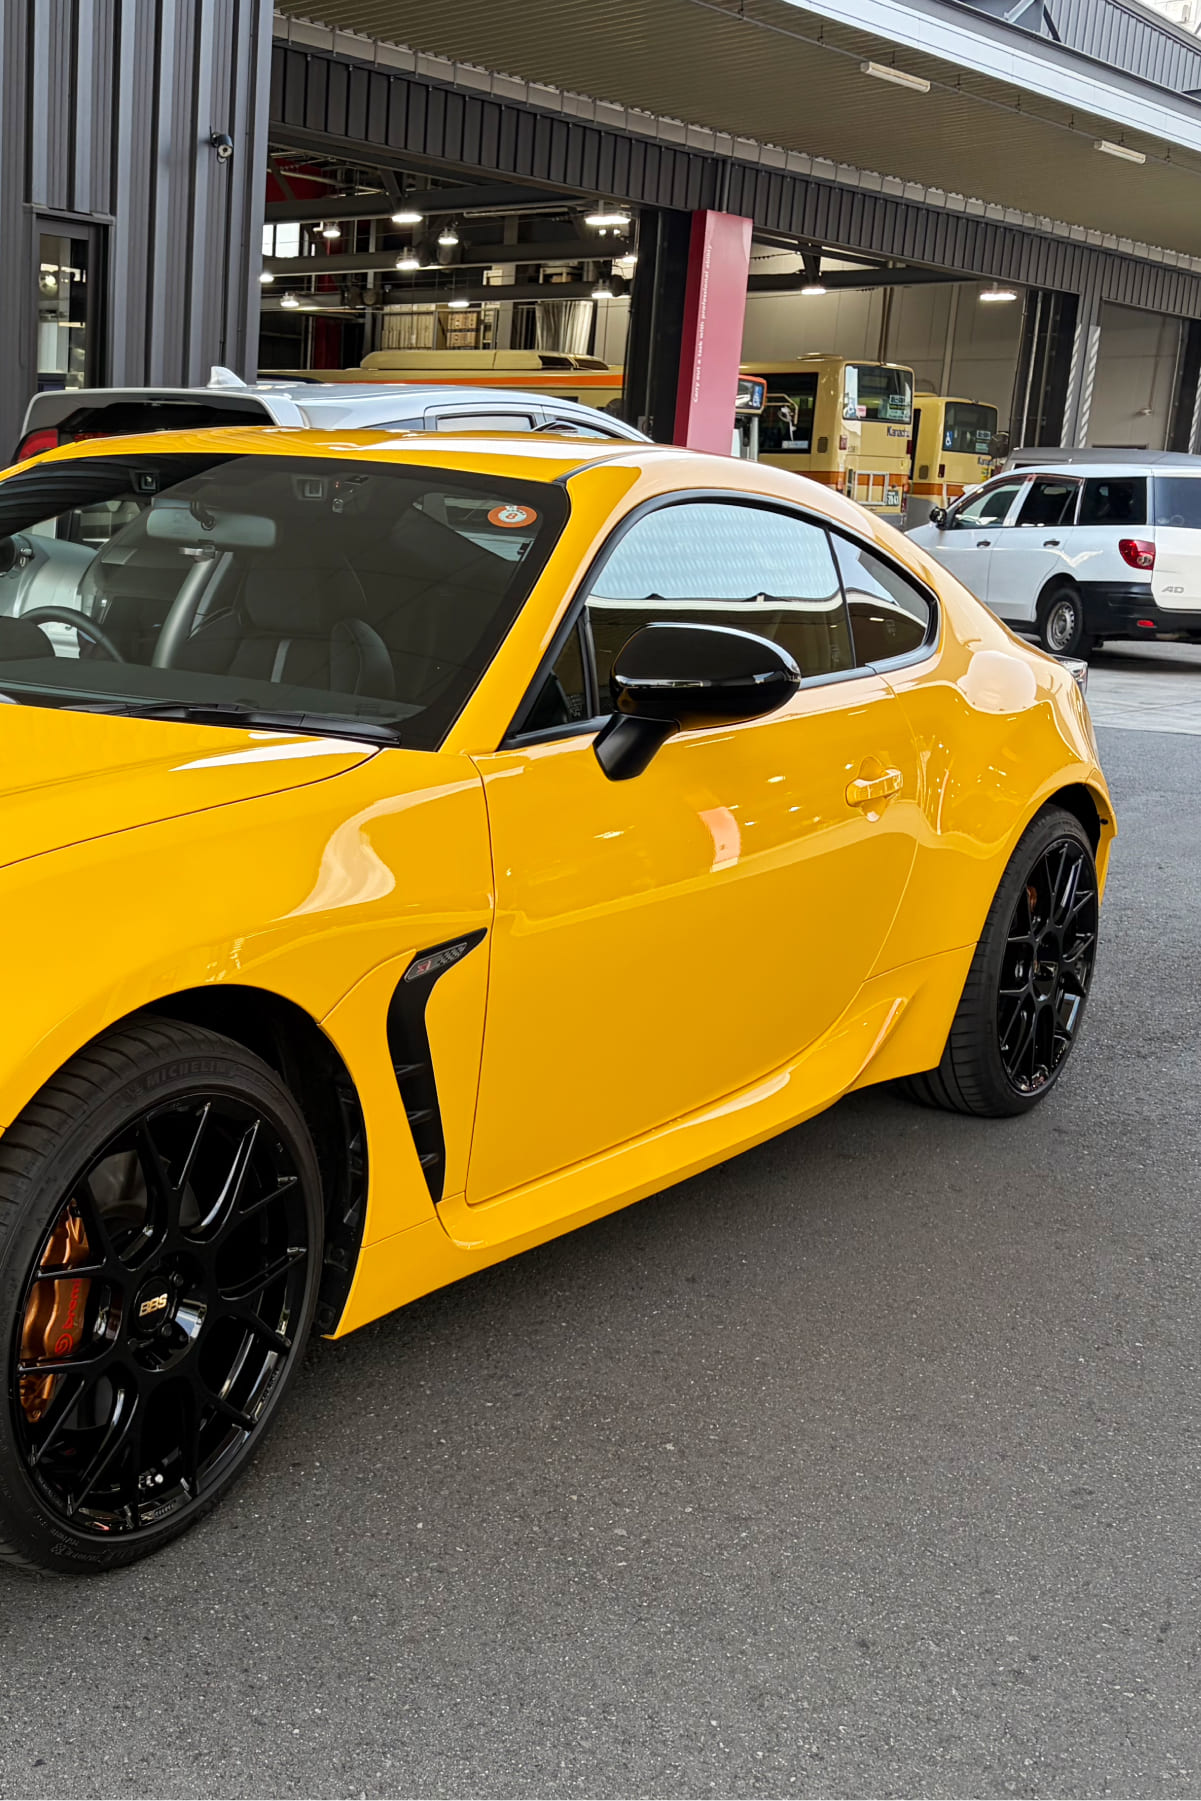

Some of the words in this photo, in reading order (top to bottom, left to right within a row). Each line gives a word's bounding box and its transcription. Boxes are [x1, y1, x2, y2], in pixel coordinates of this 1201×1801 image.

[1161, 586, 1185, 594] AD
[146, 1060, 227, 1088] MICHELIN
[139, 1293, 168, 1317] BBS
